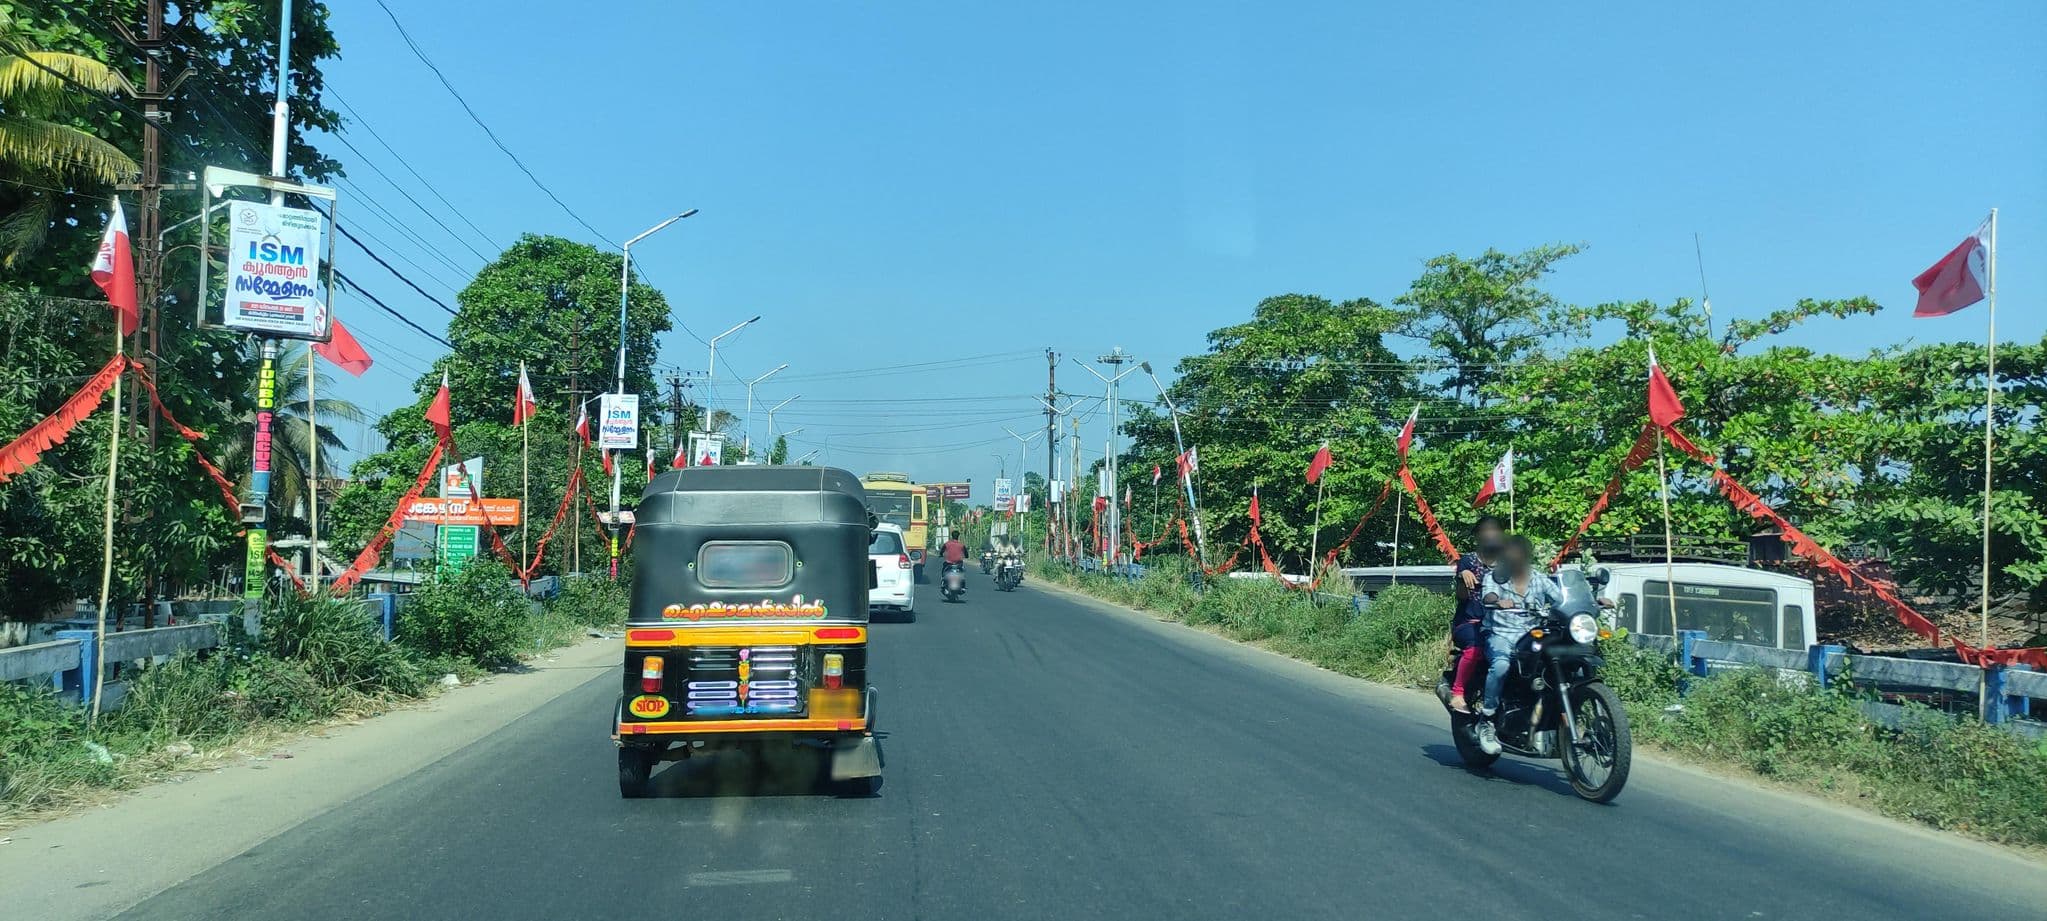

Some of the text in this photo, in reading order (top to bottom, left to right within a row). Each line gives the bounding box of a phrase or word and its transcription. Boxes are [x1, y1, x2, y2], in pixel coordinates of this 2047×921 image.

[249, 241, 304, 265] ISM
[255, 359, 276, 471] JUMBO CIRCUS
[608, 410, 631, 419] ISM
[635, 699, 665, 713] STOP
